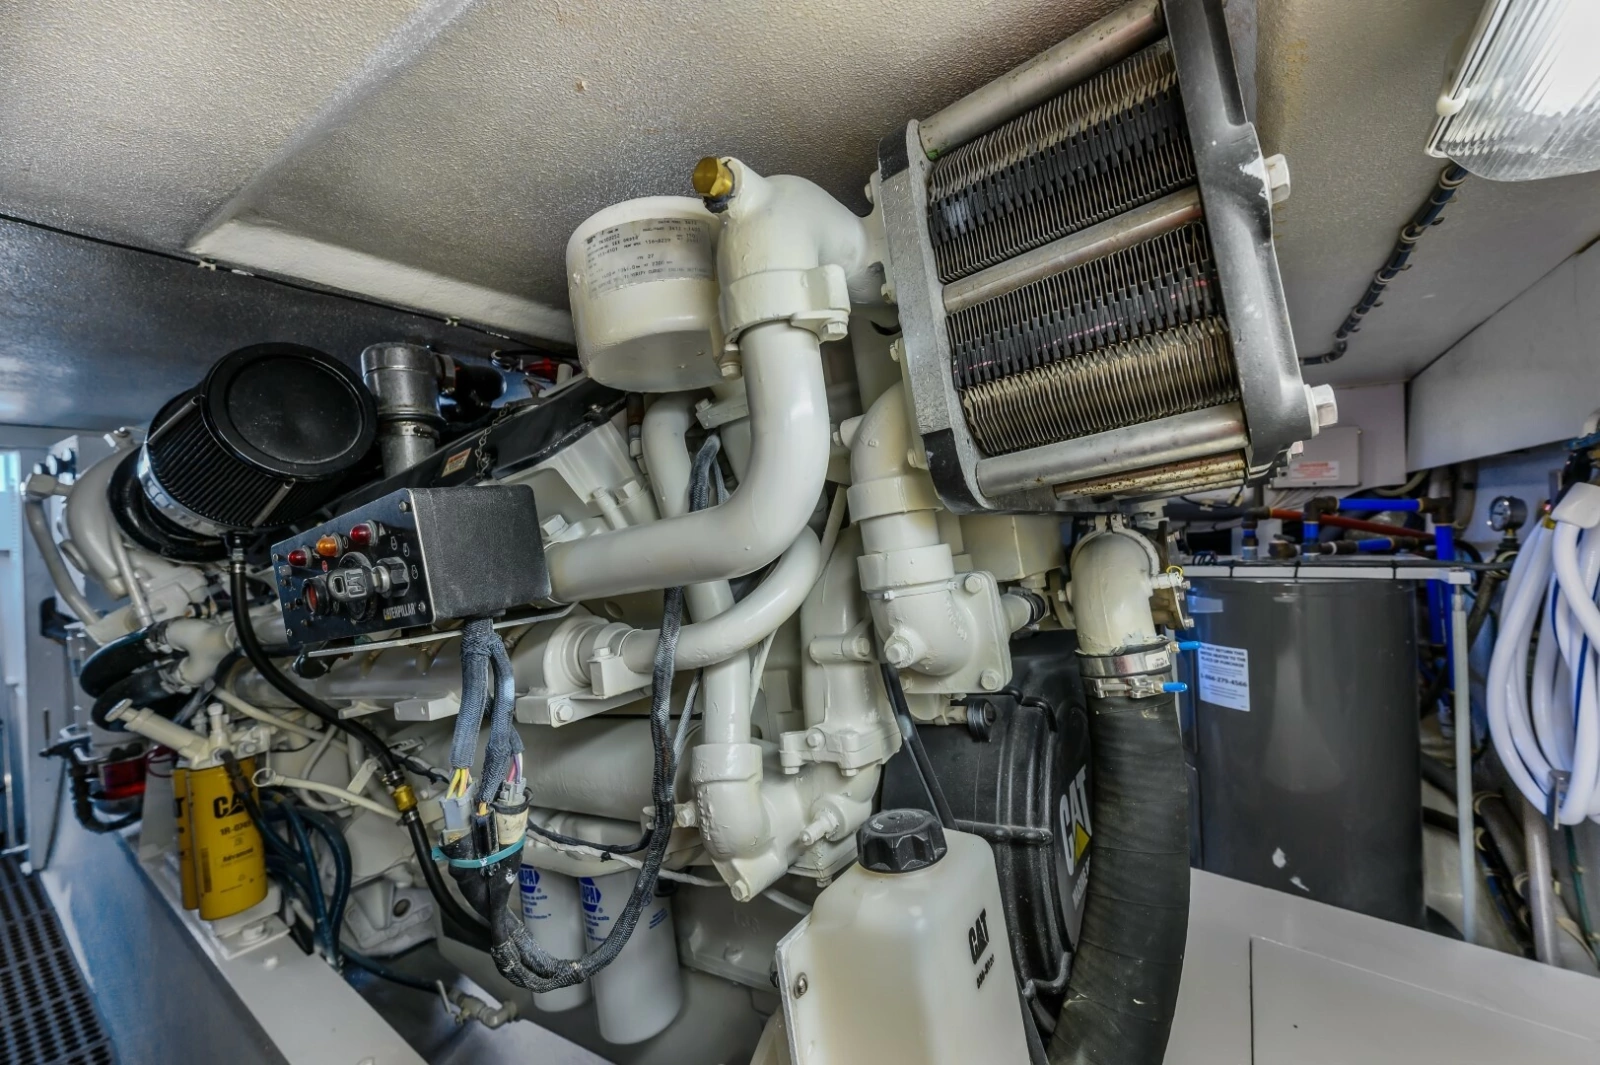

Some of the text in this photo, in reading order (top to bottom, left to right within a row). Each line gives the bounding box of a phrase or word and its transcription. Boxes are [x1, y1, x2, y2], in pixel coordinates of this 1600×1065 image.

[383, 602, 416, 621] CATERPILLAR
[213, 793, 246, 819] CA
[1060, 764, 1092, 876] CAT
[968, 907, 989, 965] CAT
